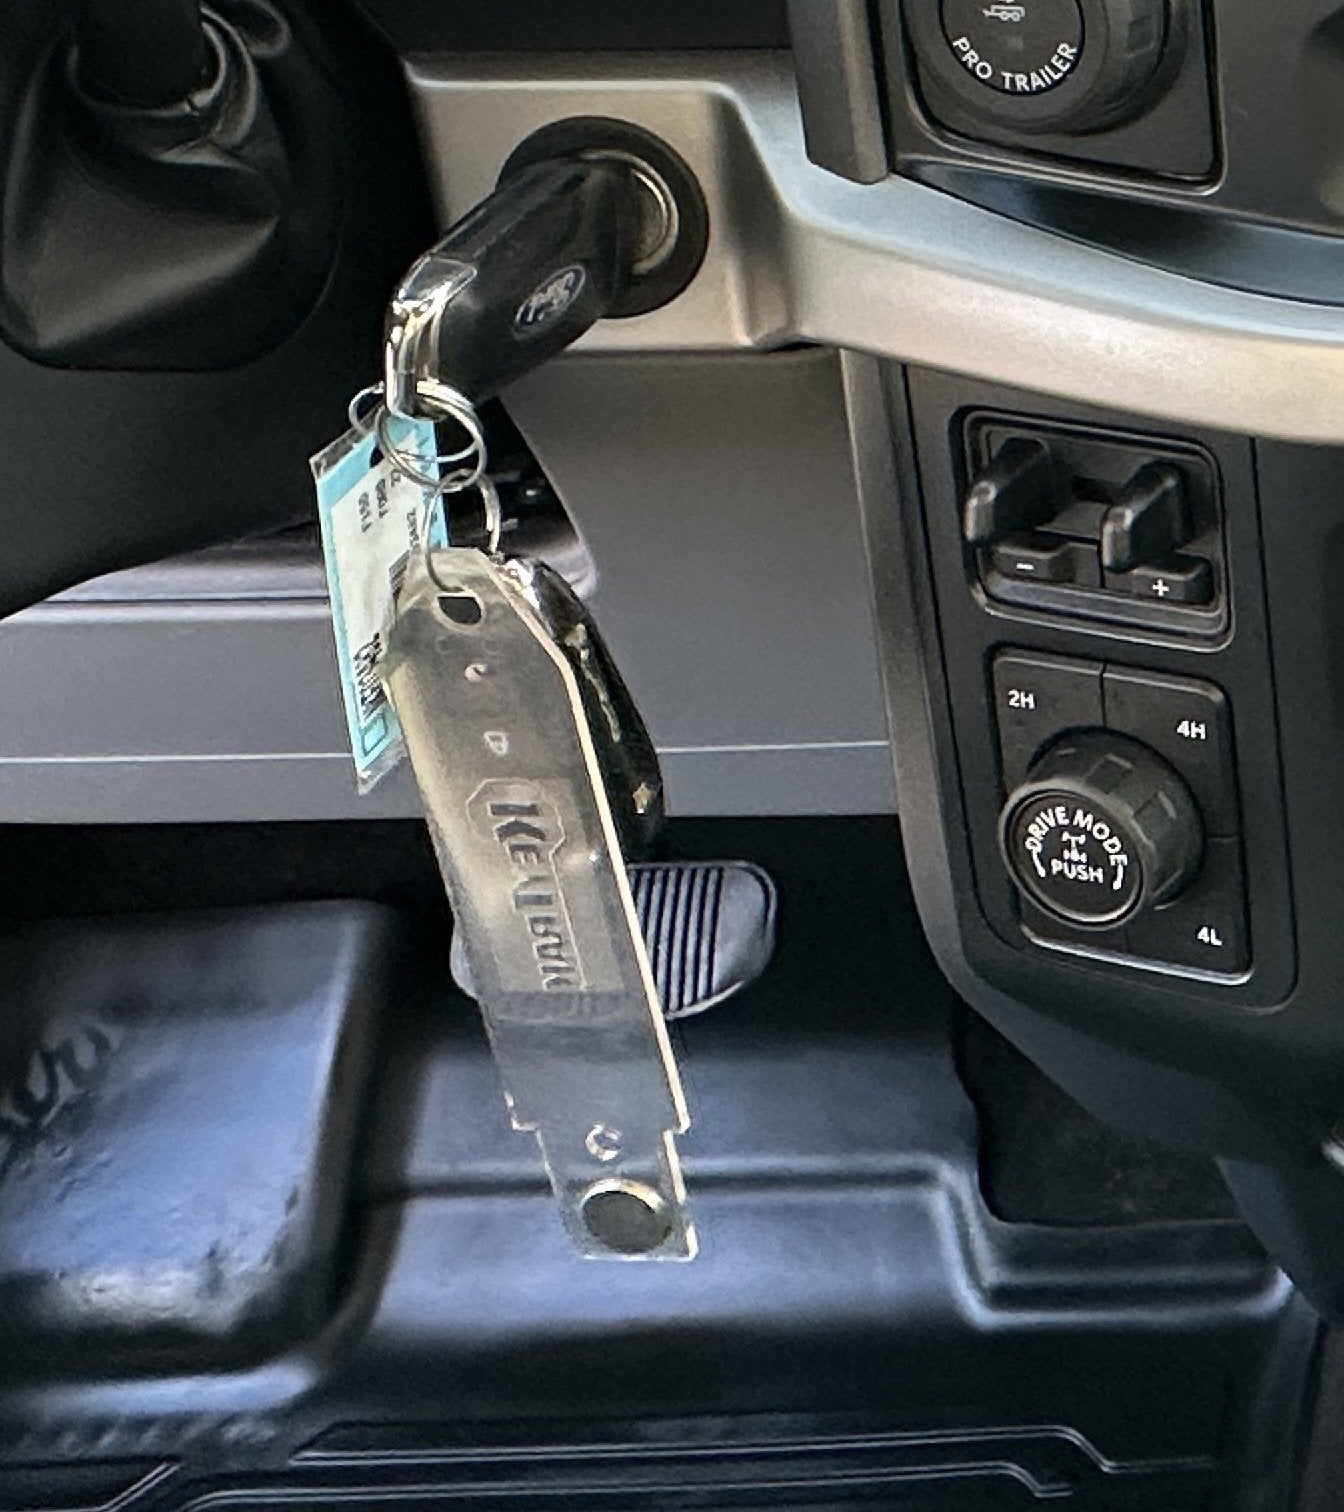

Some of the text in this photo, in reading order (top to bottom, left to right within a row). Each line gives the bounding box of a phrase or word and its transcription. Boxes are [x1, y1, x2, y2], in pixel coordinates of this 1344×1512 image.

[953, 37, 1077, 92] PRO TRAILER
[1007, 689, 1035, 710] 2H
[1176, 720, 1206, 740] 4H
[1025, 806, 1128, 866] DRIVE MODE
[1051, 858, 1104, 884] PUSH
[1197, 926, 1222, 947] 4L
